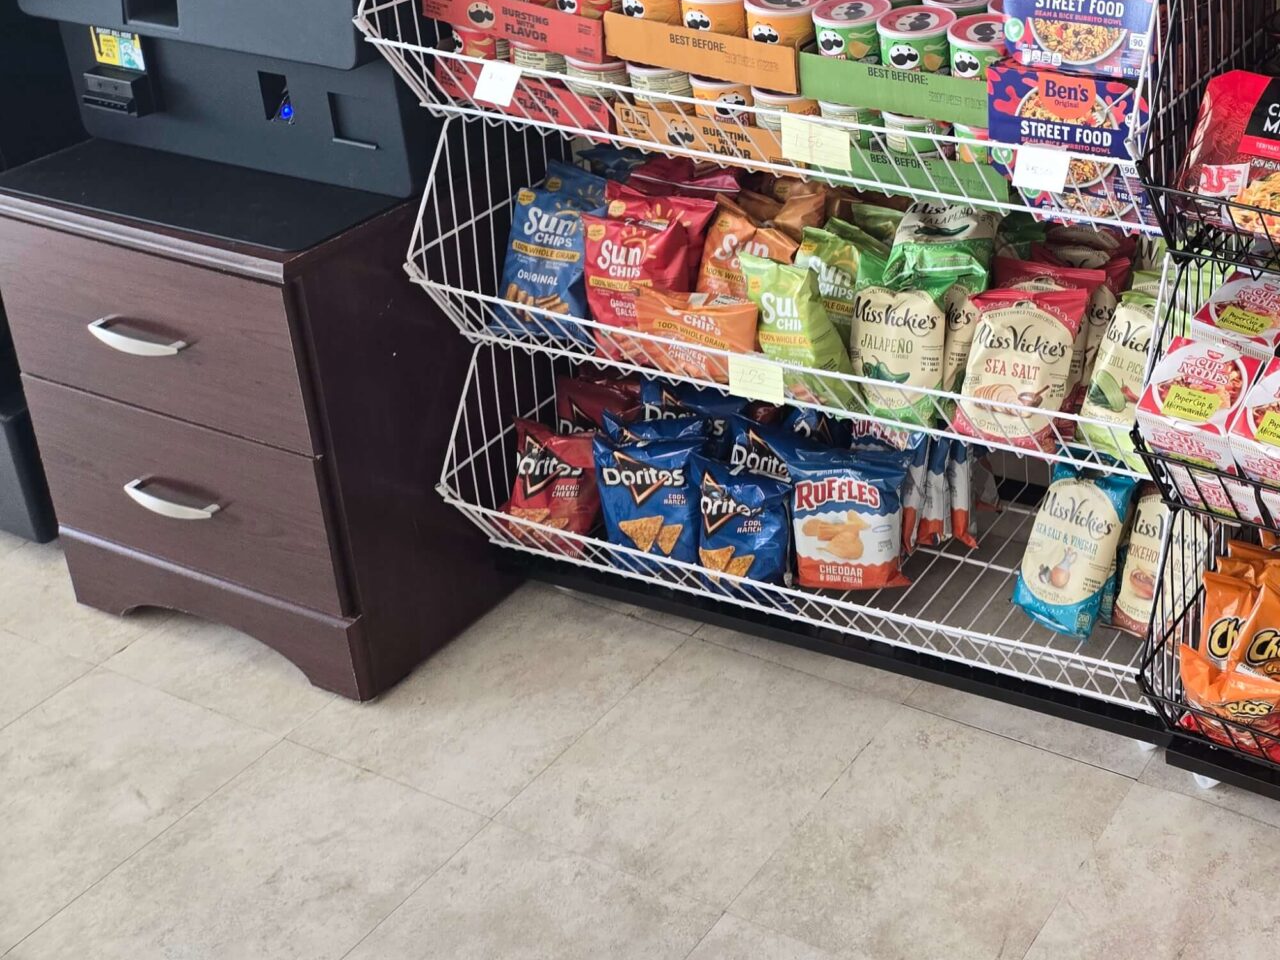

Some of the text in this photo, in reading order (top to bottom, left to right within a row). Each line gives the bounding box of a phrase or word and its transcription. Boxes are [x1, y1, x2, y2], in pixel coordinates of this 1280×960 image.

[502, 6, 549, 26] BURSTING
[1089, 0, 1124, 18] FOOD
[504, 24, 548, 42] FLAVOR
[516, 20, 535, 28] WITH
[670, 34, 726, 51] BEST BEFORE:
[868, 67, 929, 85] BEST BEFORE:
[1045, 80, 1089, 102] Ben's
[1020, 120, 1112, 146] STREET FOOD
[1256, 142, 1279, 151] TERIYAKI
[524, 206, 577, 236] Sun
[535, 232, 572, 247] CHIPS
[597, 240, 646, 269] Sun
[517, 269, 559, 285] ORIGINAL
[608, 265, 641, 278] CHIPS
[860, 332, 914, 355] JALAPEÑO
[974, 323, 1067, 363] Miss Vickie's
[985, 358, 1040, 380] SEA SALT
[1178, 364, 1229, 385] NOODLES
[1195, 358, 1224, 374] CUP
[1166, 401, 1209, 419] Microwavable
[517, 451, 583, 477] Doritos
[602, 467, 685, 487] Doritos
[552, 489, 579, 498] CHEESE
[554, 484, 579, 492] NACHO
[795, 477, 880, 510] RUFFLES
[736, 526, 762, 534] RANCH
[744, 520, 762, 528] COOL
[819, 564, 863, 578] CHEDDAR
